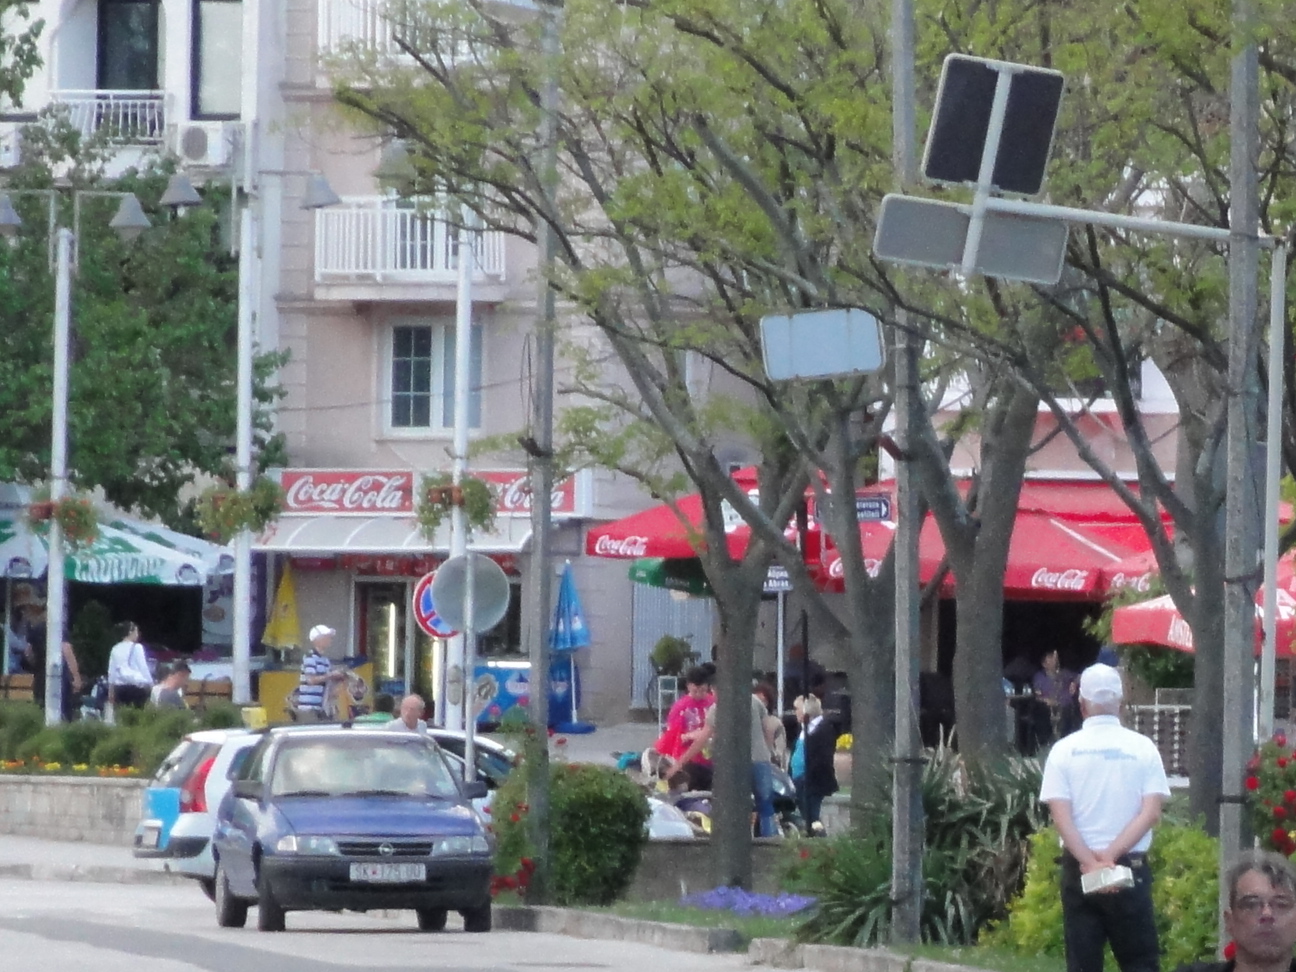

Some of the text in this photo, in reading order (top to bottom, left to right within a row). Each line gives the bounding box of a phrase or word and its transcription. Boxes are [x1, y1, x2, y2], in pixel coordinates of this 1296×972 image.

[286, 475, 406, 508] Coca-Cola
[595, 535, 648, 555] Coca-Cola
[1031, 567, 1088, 590] Coca-Cola
